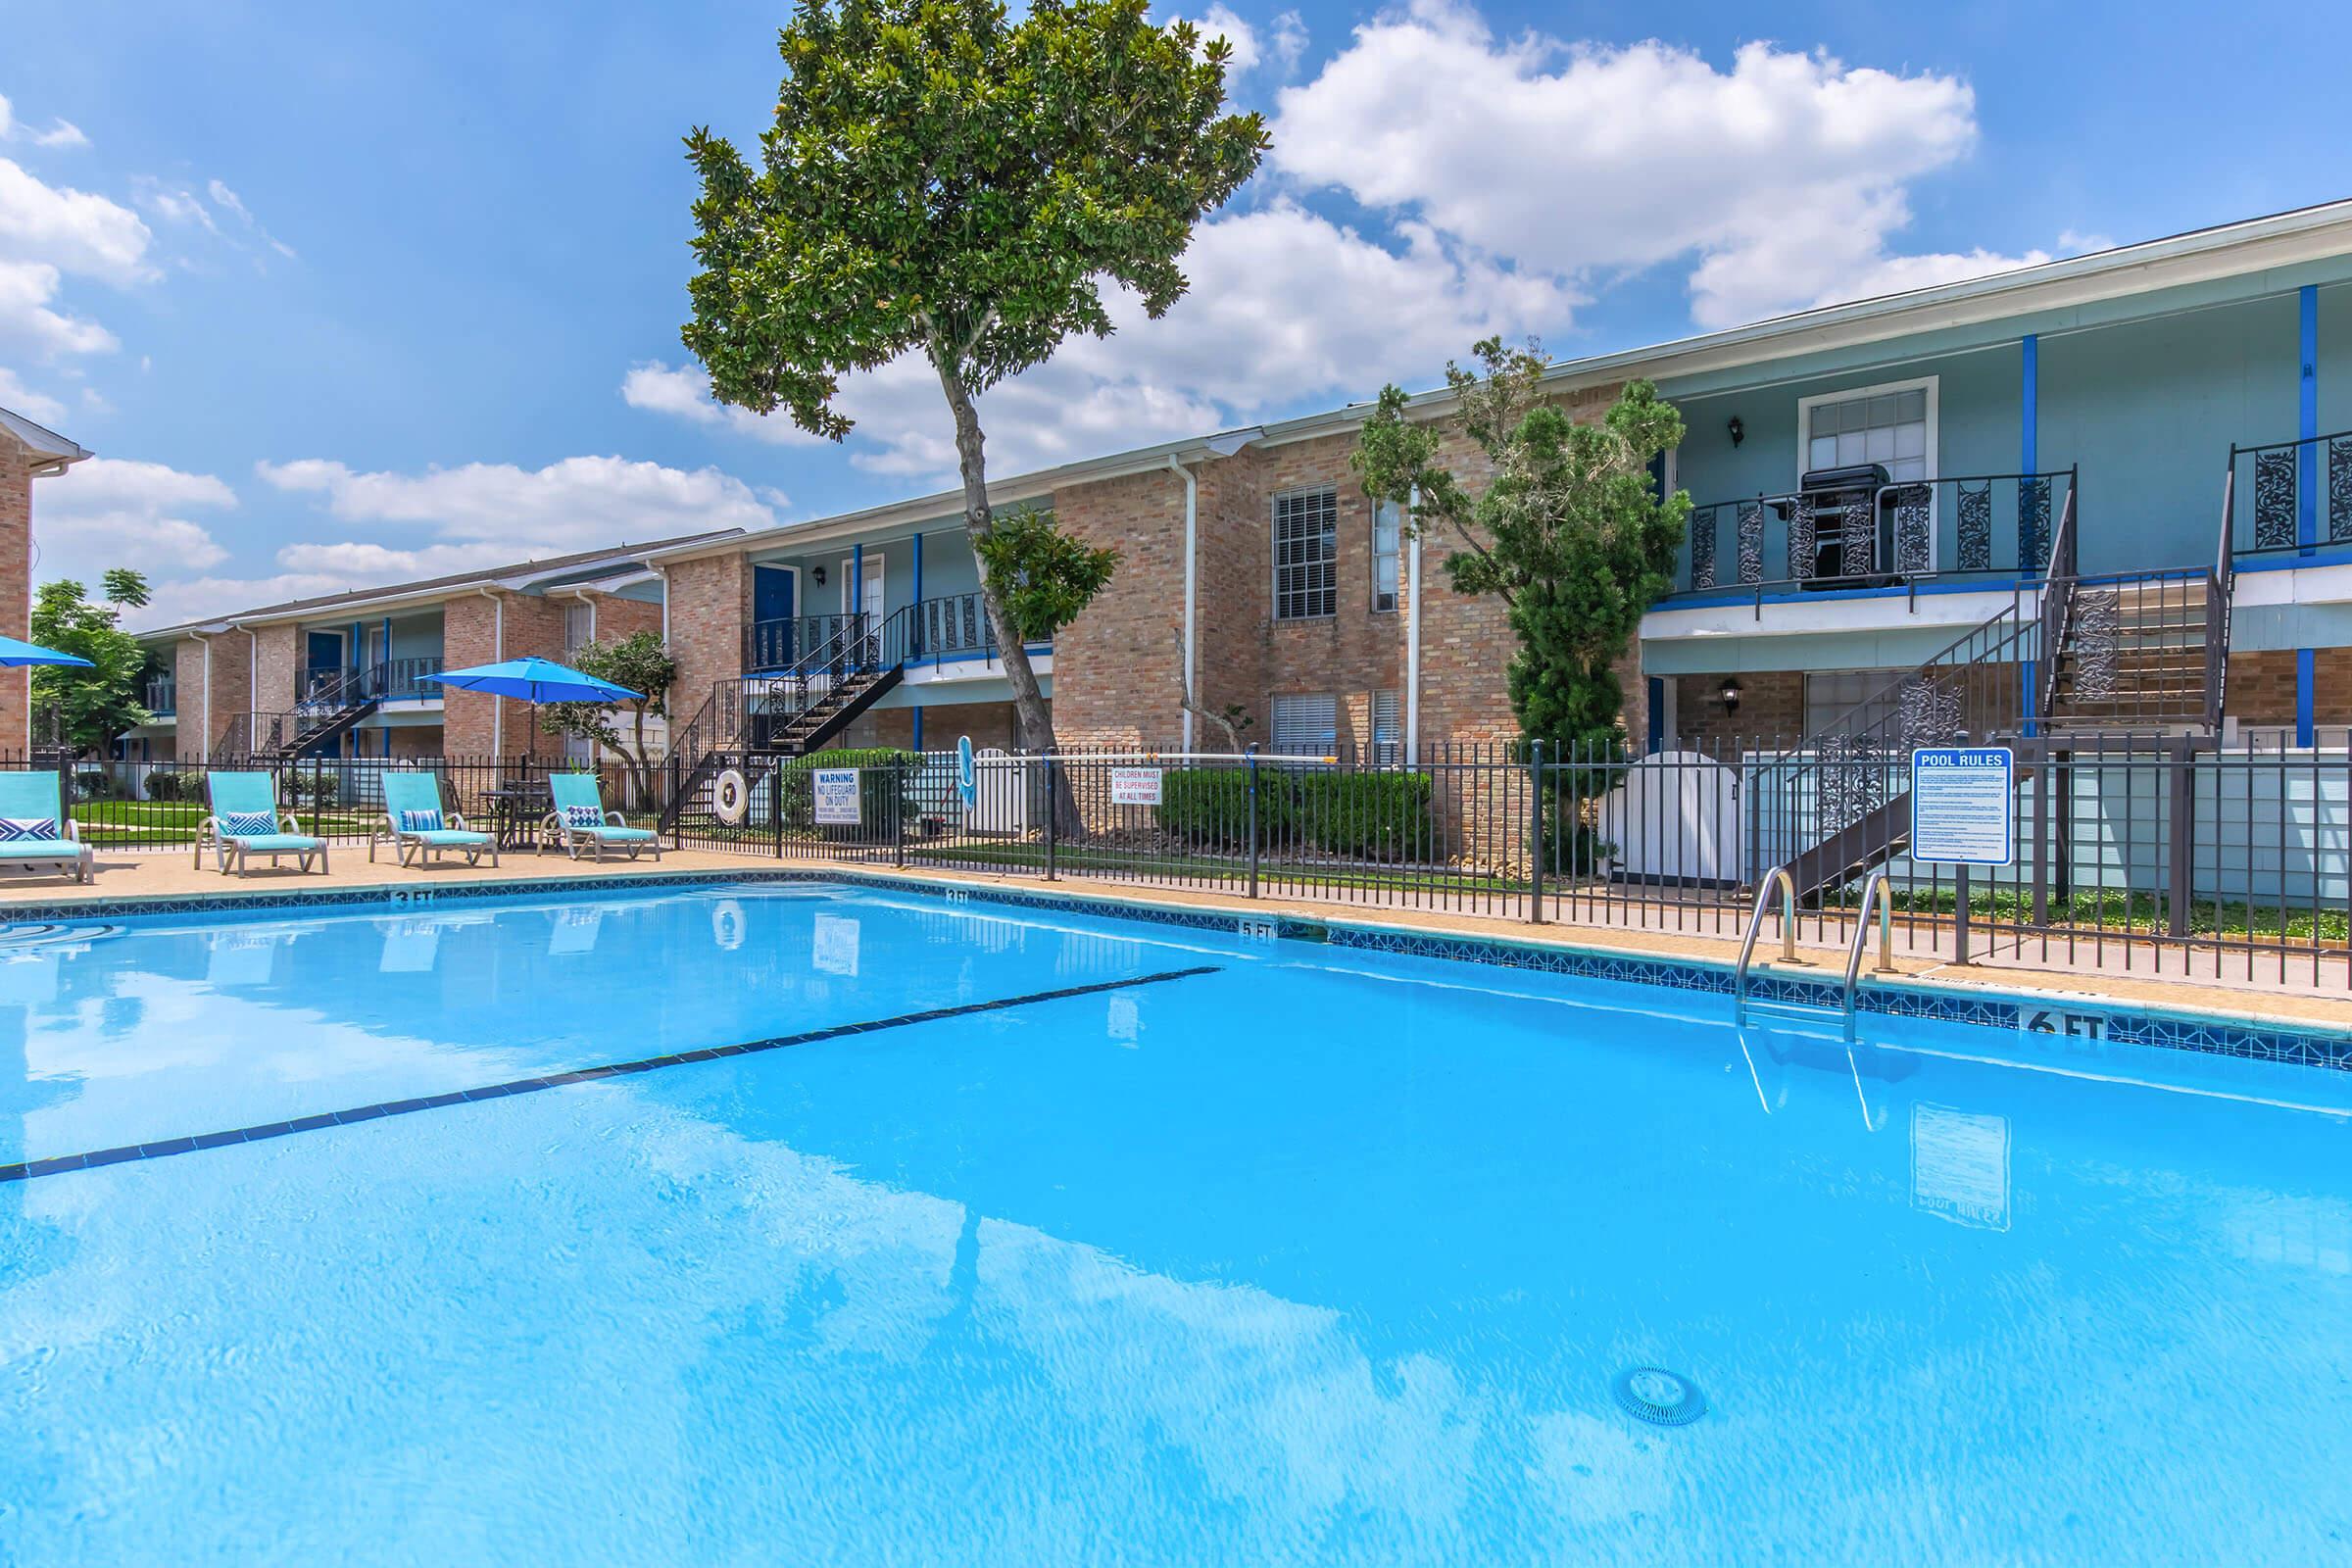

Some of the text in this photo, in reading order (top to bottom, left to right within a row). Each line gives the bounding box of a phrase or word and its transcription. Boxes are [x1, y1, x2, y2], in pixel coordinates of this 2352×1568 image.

[1921, 755, 2003, 766] POOL RULES
[819, 773, 855, 783] WARNING
[1143, 770, 1159, 779] MUST
[817, 784, 857, 795] NO LIFEGUARD
[1124, 781, 1158, 790] SUPERVISED
[825, 795, 849, 806] ON DUTY
[1139, 792, 1156, 801] TIMES
[395, 890, 432, 902] 3 FT
[1243, 922, 1271, 939] 5 FT
[2028, 1010, 2104, 1040] 6 FT
